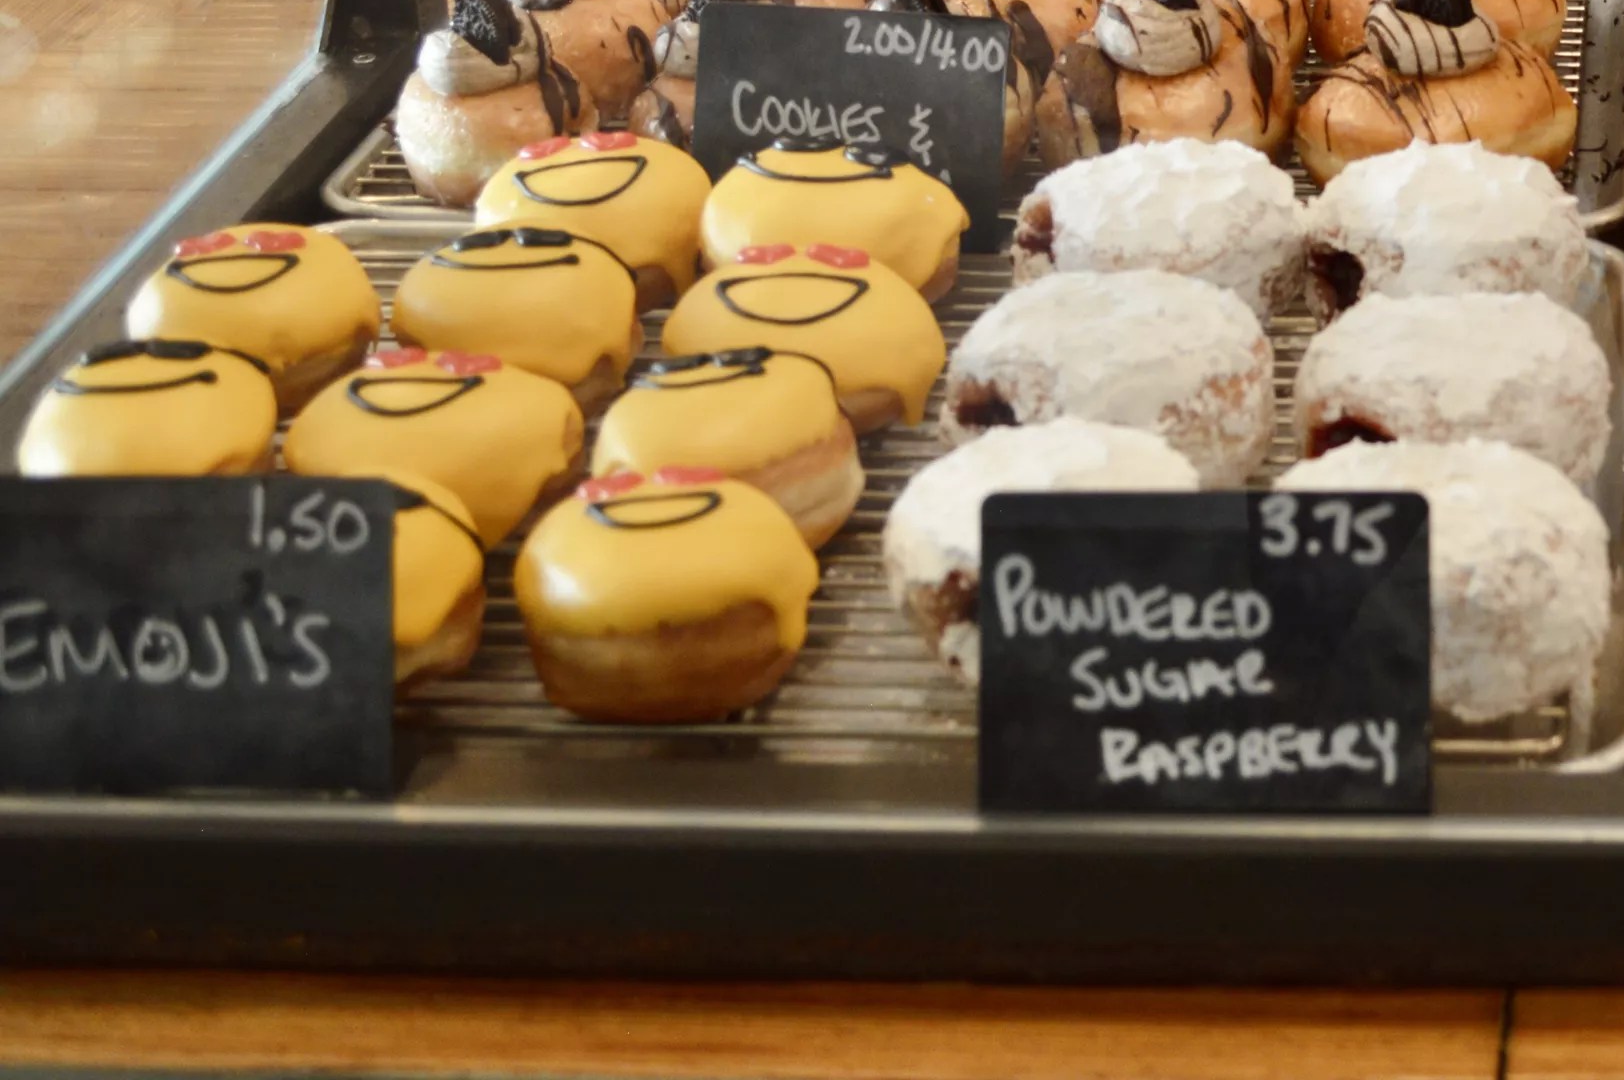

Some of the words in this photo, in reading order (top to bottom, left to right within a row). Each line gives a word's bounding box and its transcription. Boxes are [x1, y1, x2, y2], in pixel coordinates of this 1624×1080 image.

[845, 16, 1005, 71] 2.00/4.00
[732, 80, 885, 143] COOKIES
[909, 104, 933, 166] &
[250, 483, 370, 554] 1.50
[1260, 494, 1395, 566] 3.75
[995, 554, 1272, 641] POWDERED
[0, 592, 331, 693] EMOJI'S
[1071, 647, 1275, 711] SUGAR
[1100, 719, 1397, 785] RASPBERRY
